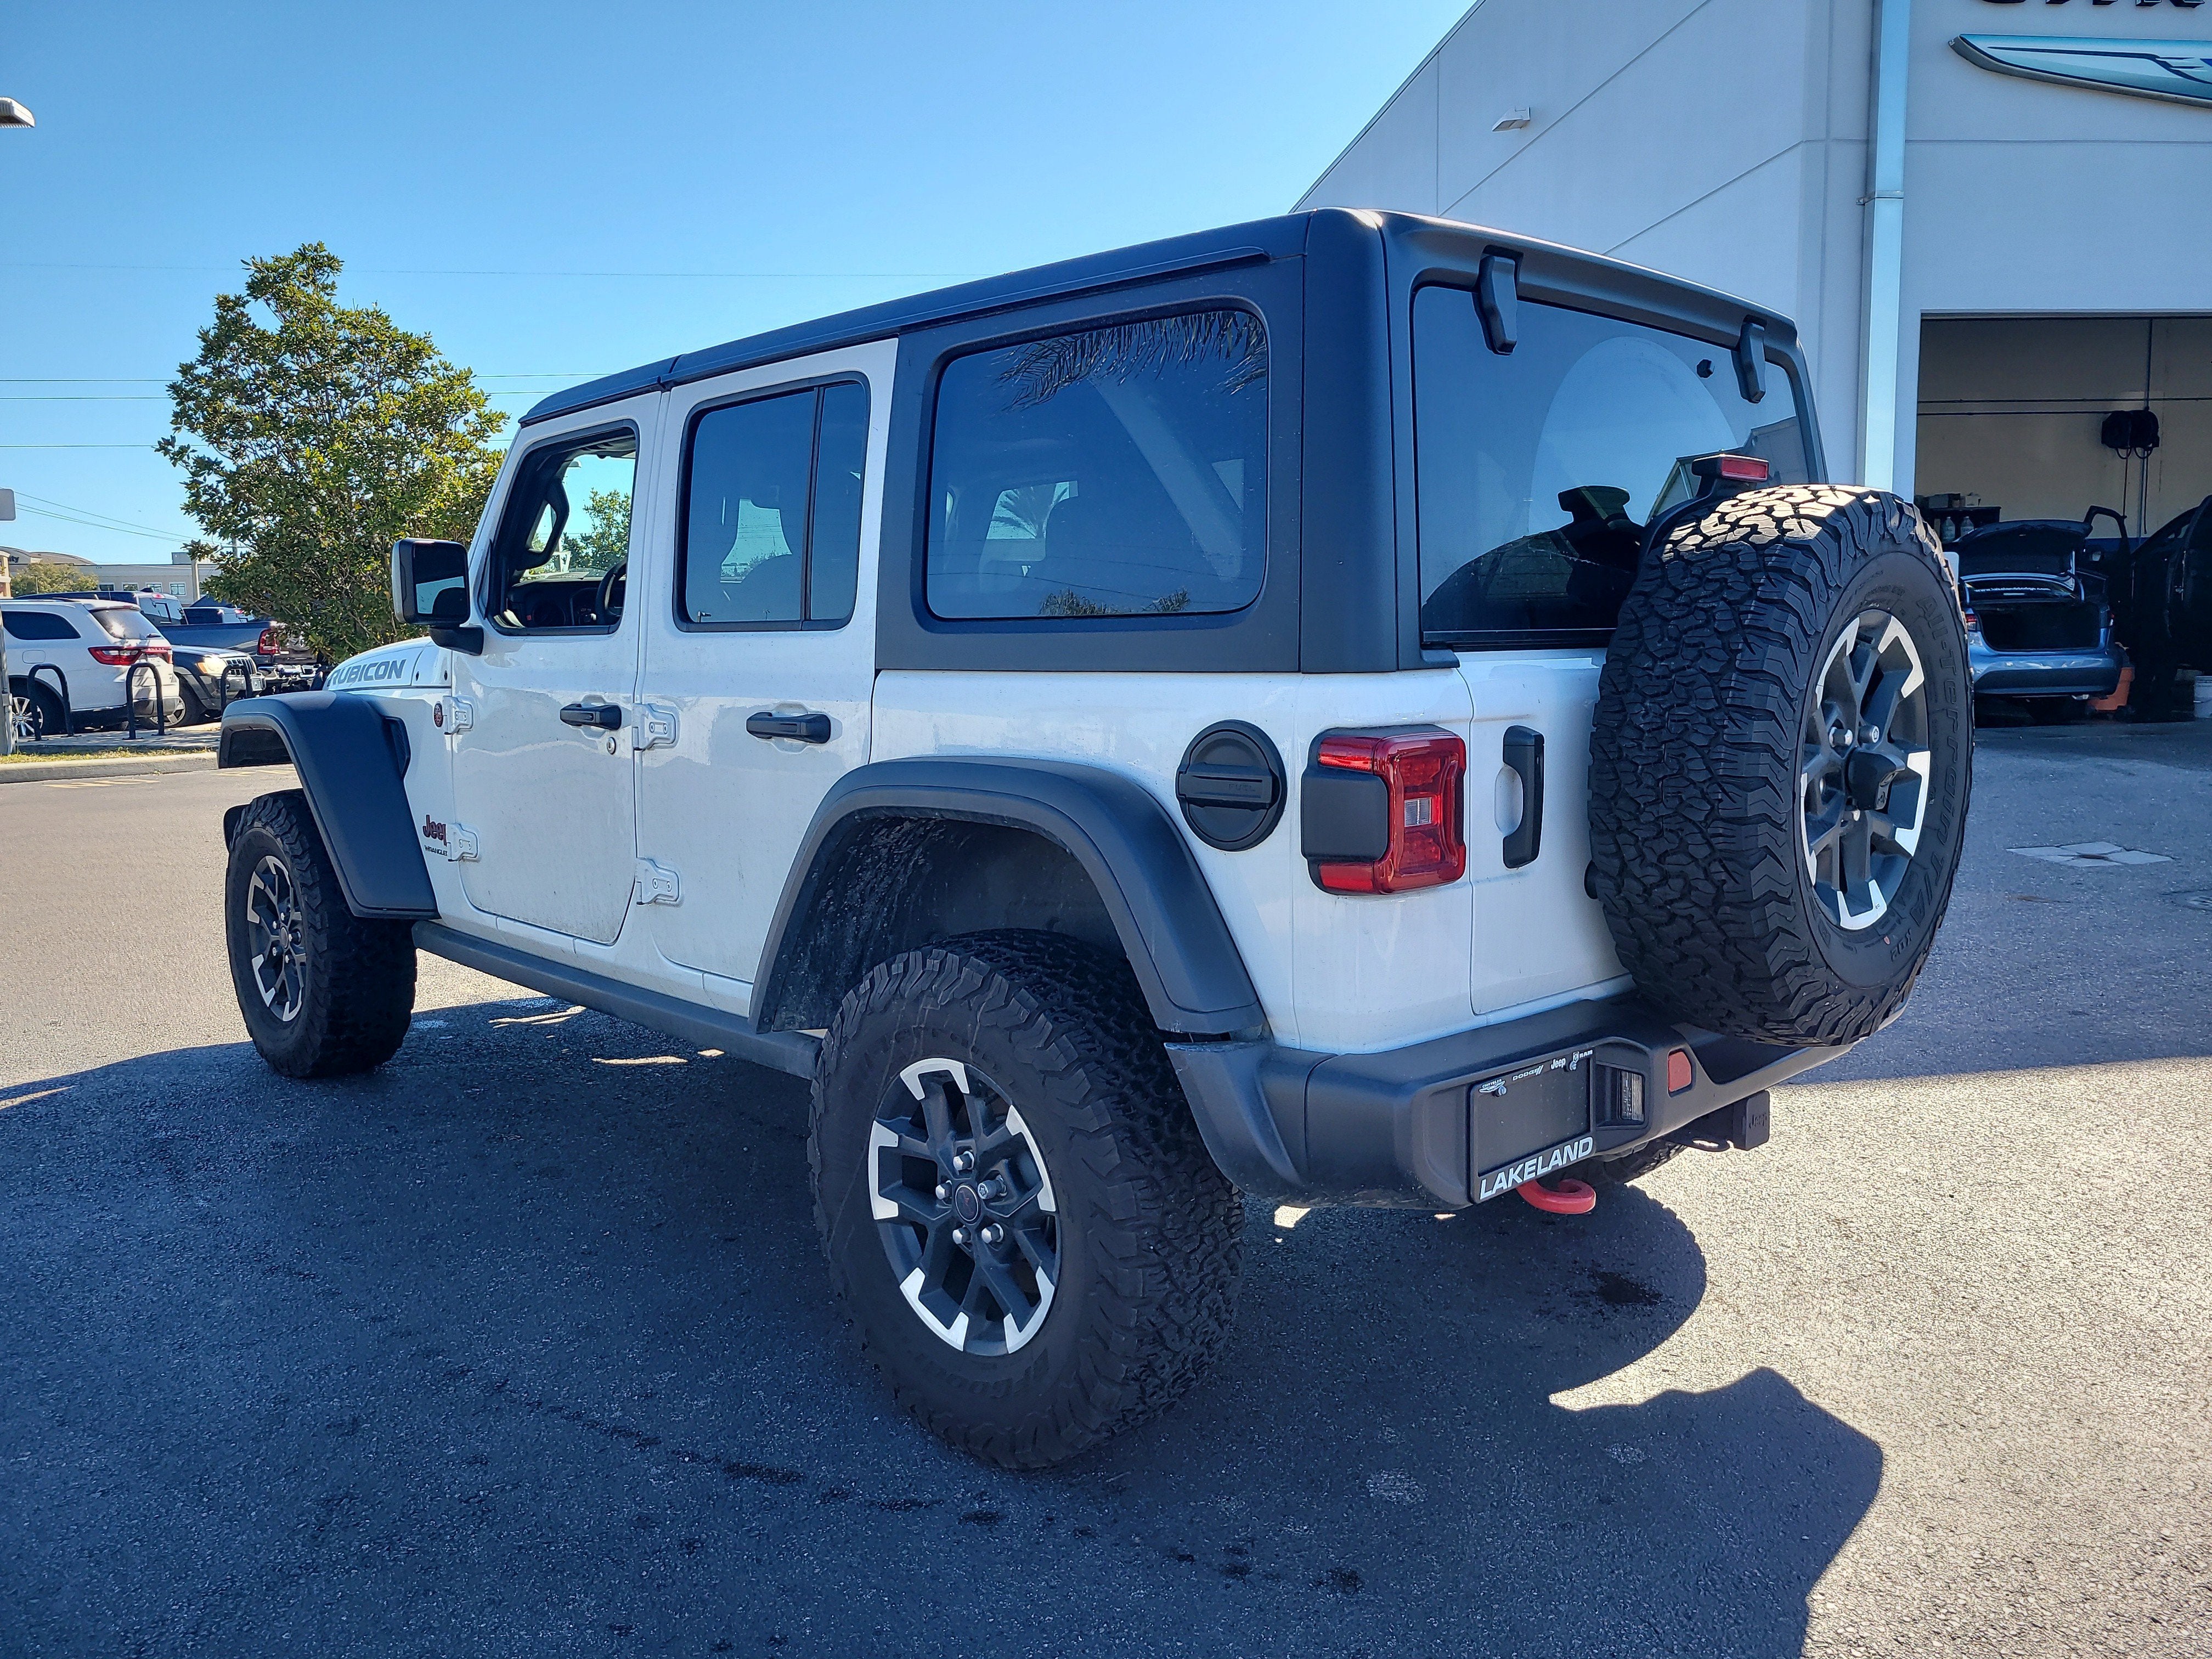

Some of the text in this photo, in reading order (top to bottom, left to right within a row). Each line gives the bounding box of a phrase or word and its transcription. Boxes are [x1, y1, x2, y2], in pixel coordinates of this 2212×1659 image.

[326, 659, 407, 687] RUBICON
[1228, 783, 1256, 792] FUEL
[424, 845, 448, 856] WRANGLE
[1482, 1079, 1502, 1088] CHRYSLER
[1550, 1058, 1566, 1070] Jeep
[1579, 1049, 1593, 1059] RAM
[1480, 1136, 1593, 1200] LAKELAND
